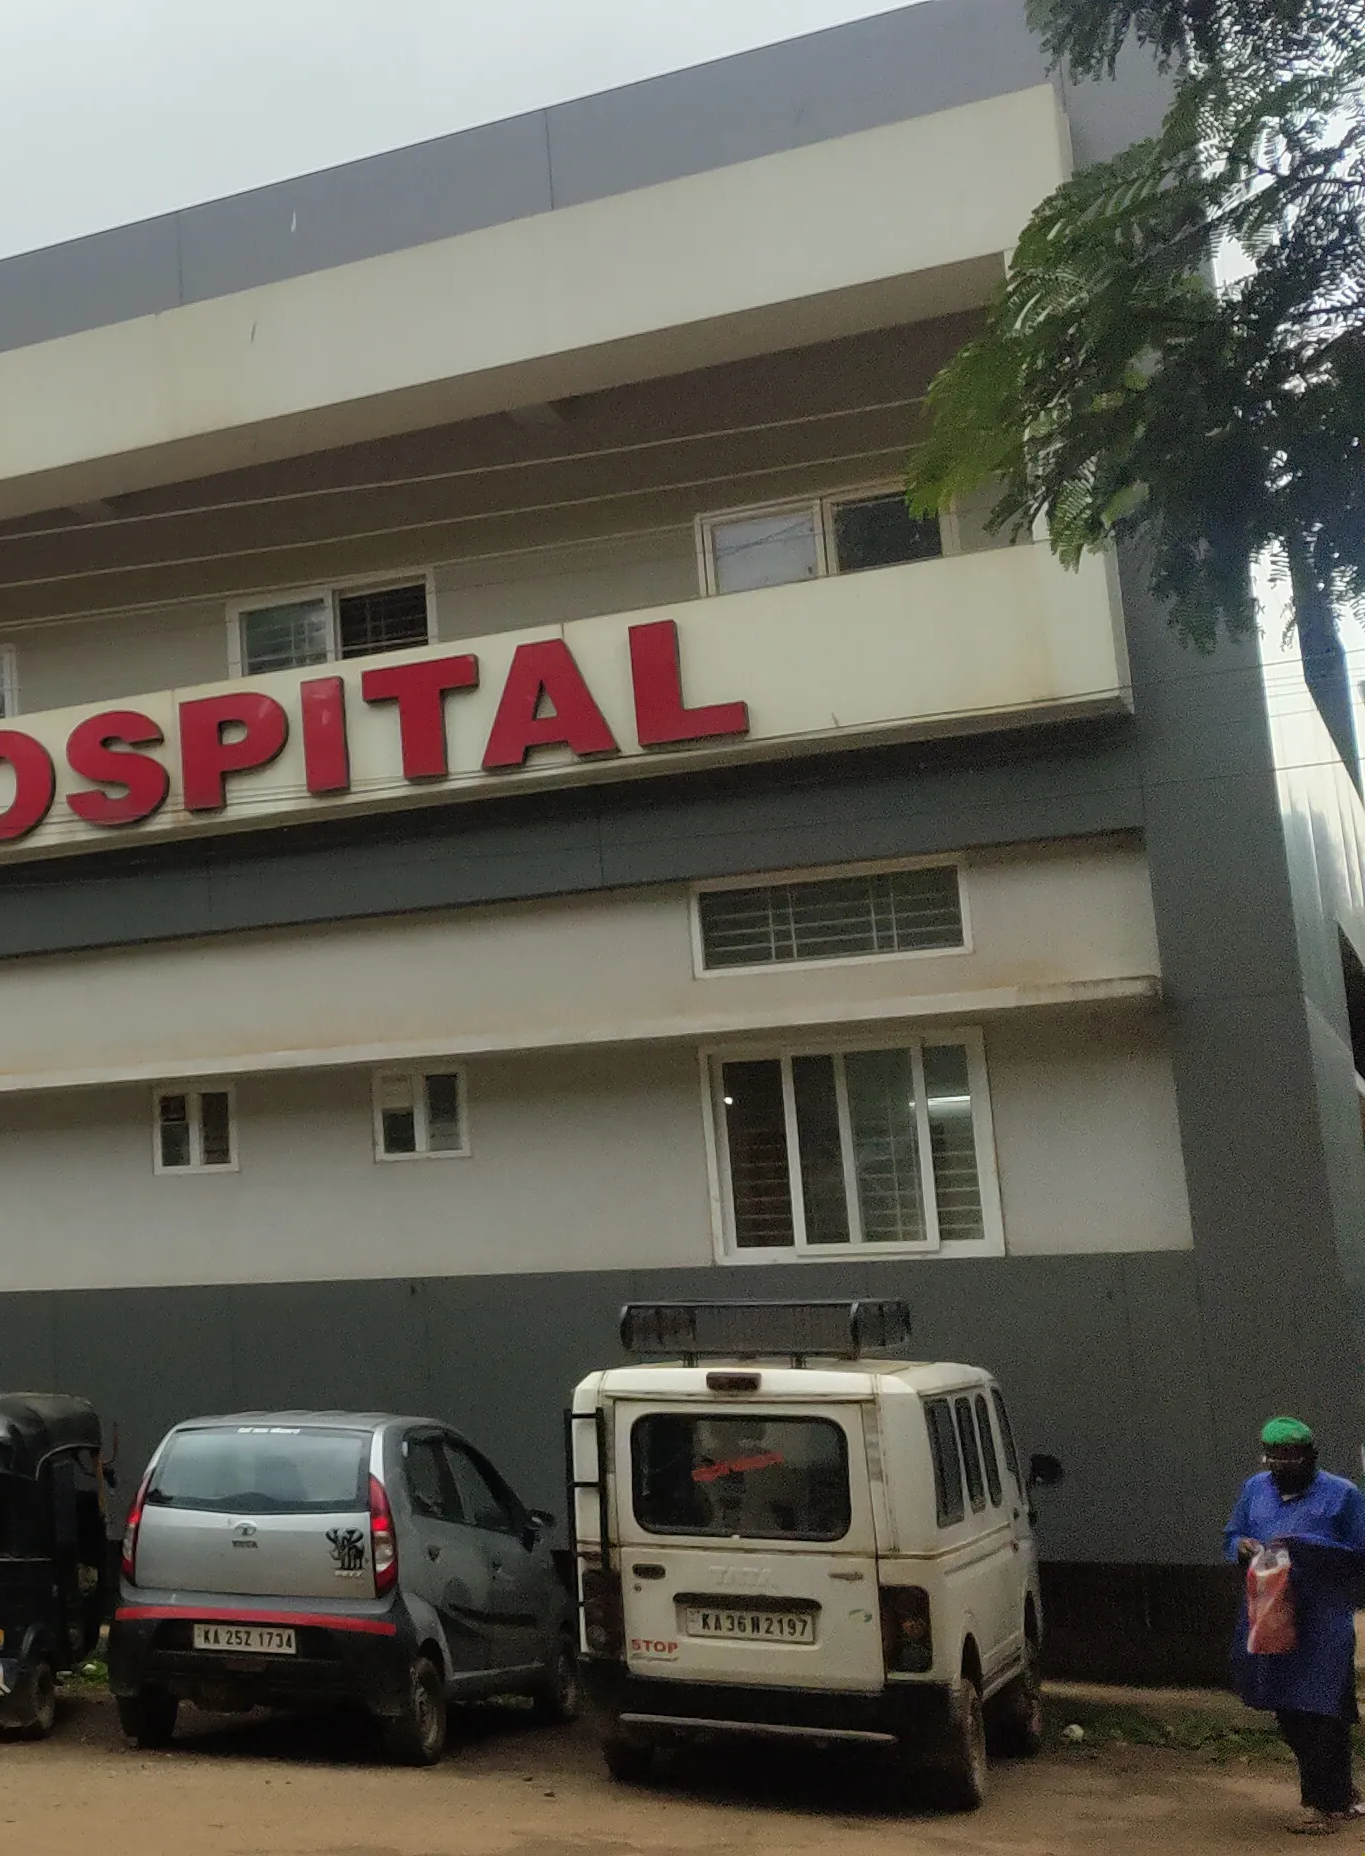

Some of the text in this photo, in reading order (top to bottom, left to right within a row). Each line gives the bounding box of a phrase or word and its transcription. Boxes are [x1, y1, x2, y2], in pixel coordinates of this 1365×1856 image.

[203, 1628, 221, 1645] KA
[258, 1631, 293, 1649] 1734
[631, 1638, 679, 1654] STOP
